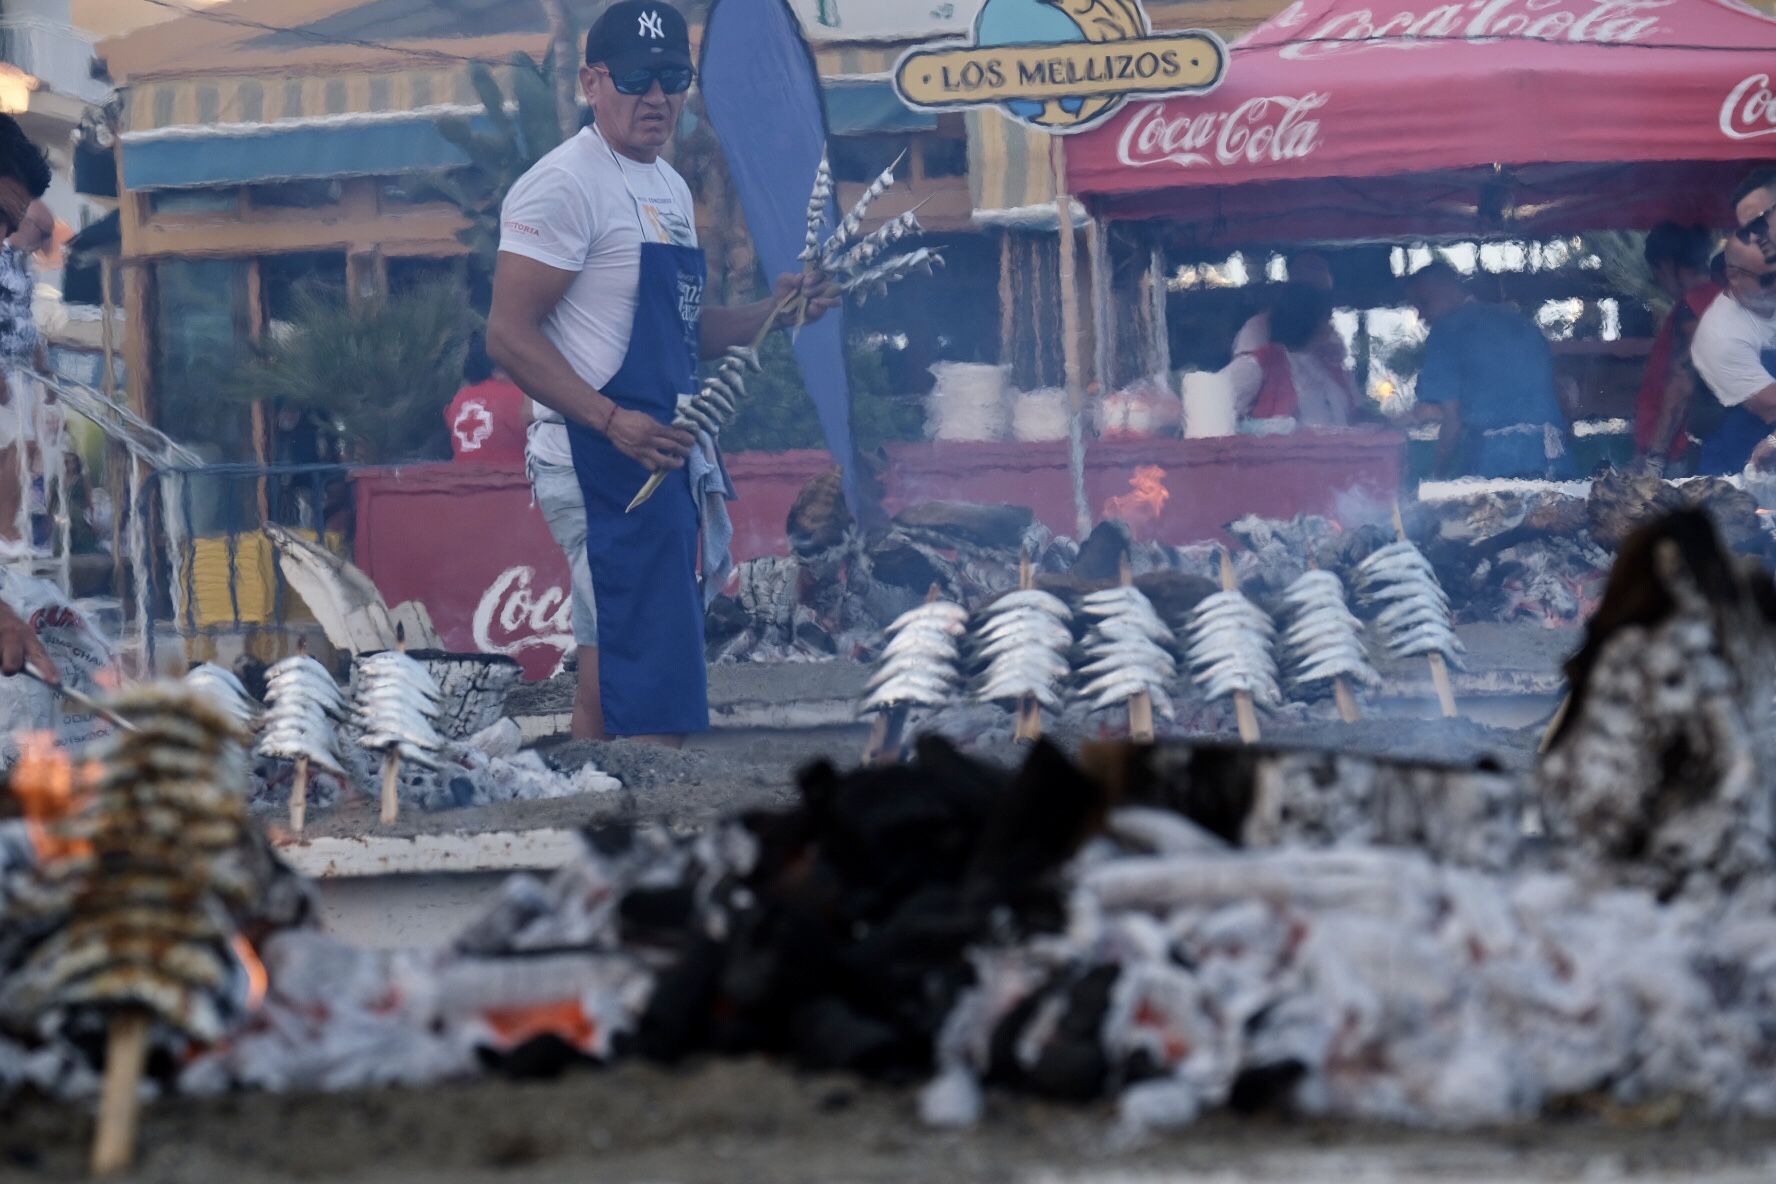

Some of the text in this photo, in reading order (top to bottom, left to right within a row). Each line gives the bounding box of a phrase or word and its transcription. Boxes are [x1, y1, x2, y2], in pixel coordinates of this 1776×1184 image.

[637, 10, 665, 39] NY
[940, 50, 1181, 92] LOS MELLIZOS
[1719, 73, 1776, 140] Co
[503, 221, 540, 236] CTORIA
